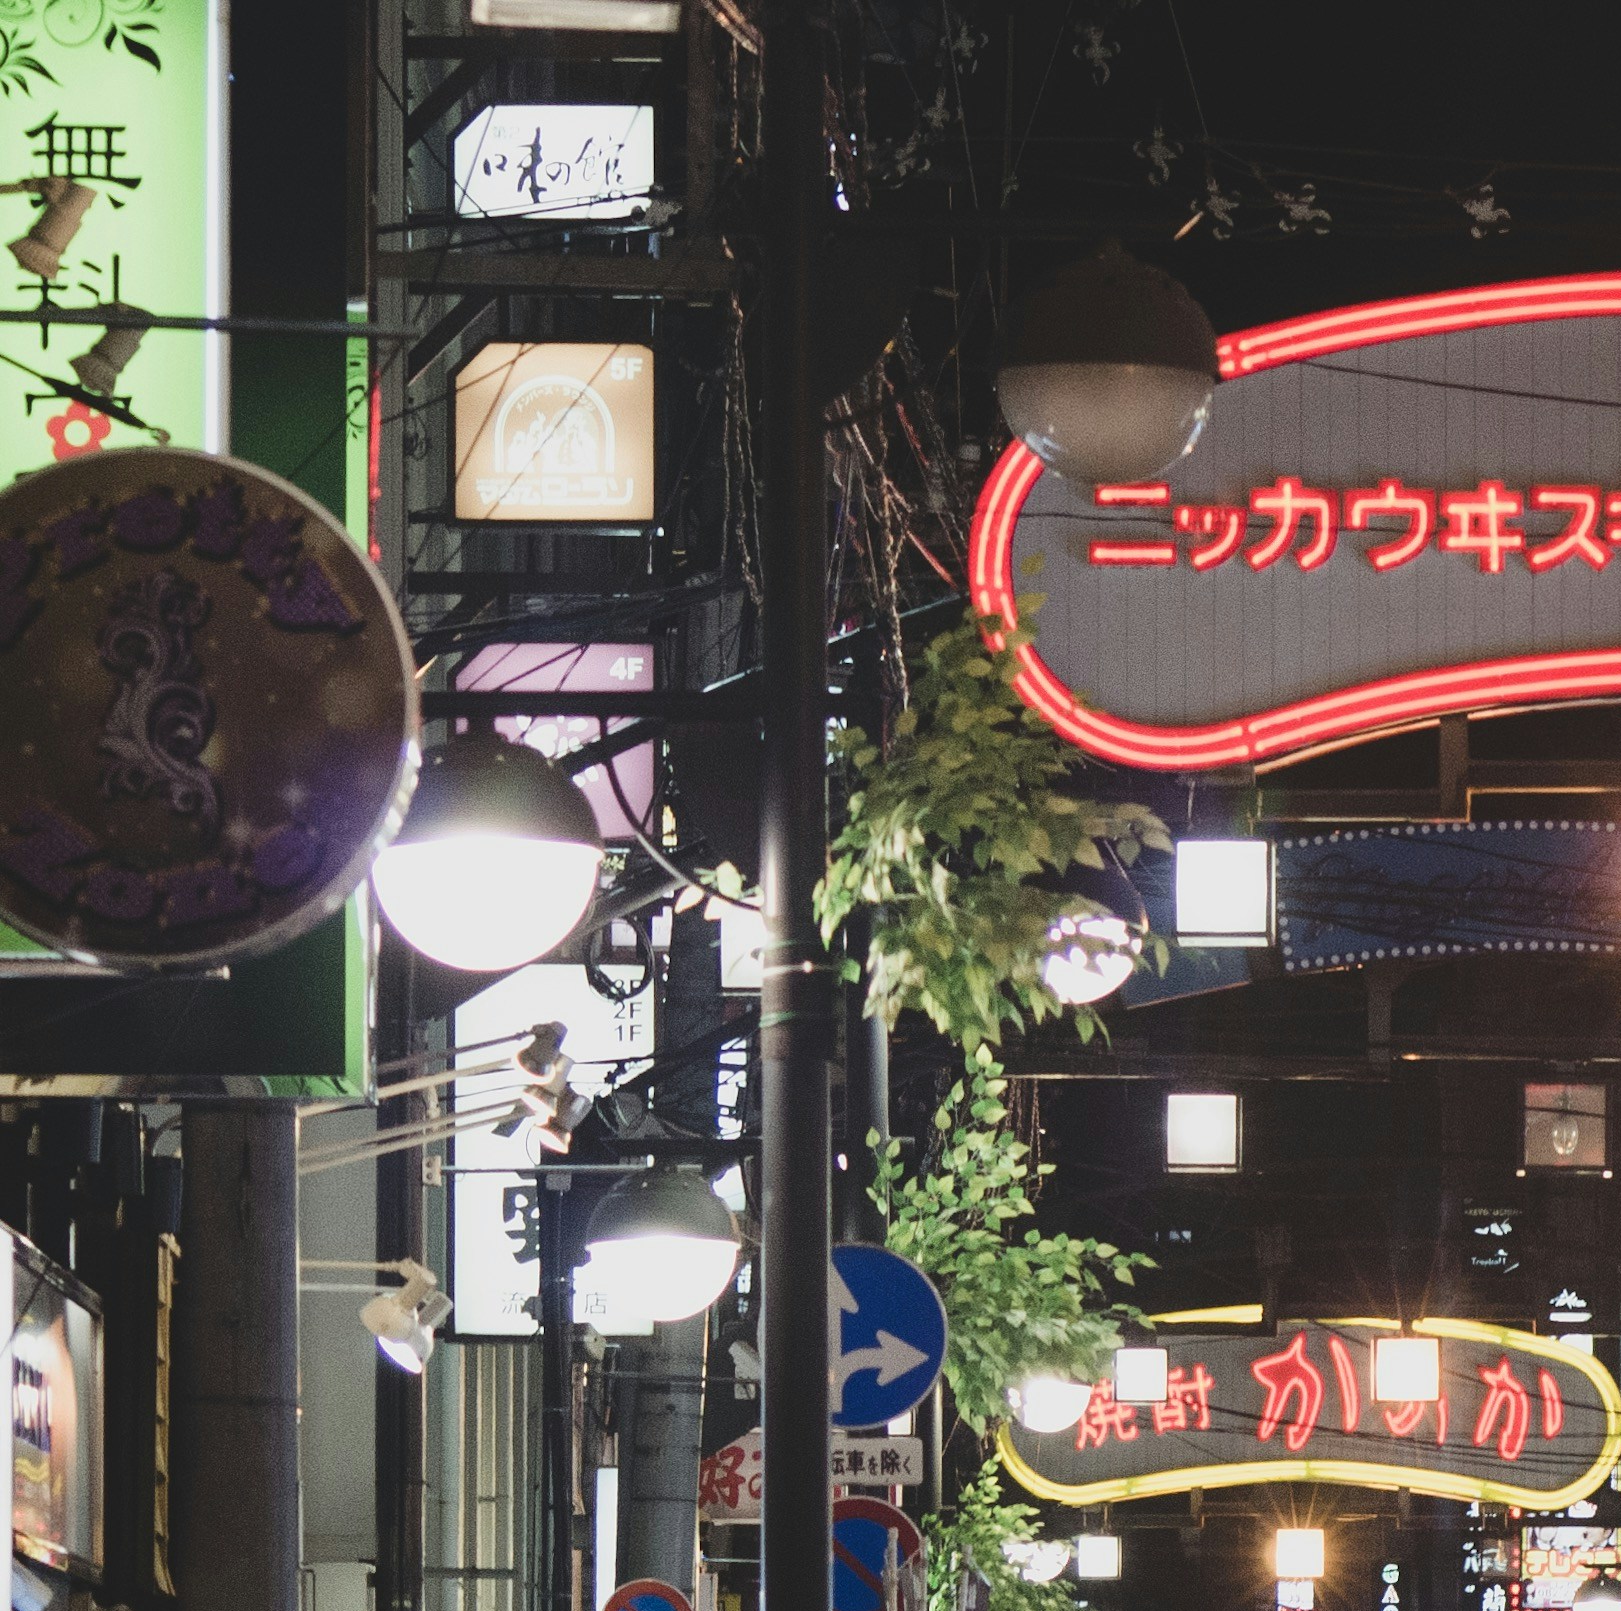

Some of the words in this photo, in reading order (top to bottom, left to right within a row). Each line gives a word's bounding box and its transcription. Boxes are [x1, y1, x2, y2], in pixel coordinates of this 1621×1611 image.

[482, 126, 625, 205] 味の館
[609, 357, 643, 381] 5F
[609, 656, 643, 681] 4F
[612, 1002, 643, 1020] 2F
[612, 1024, 643, 1042] 1F
